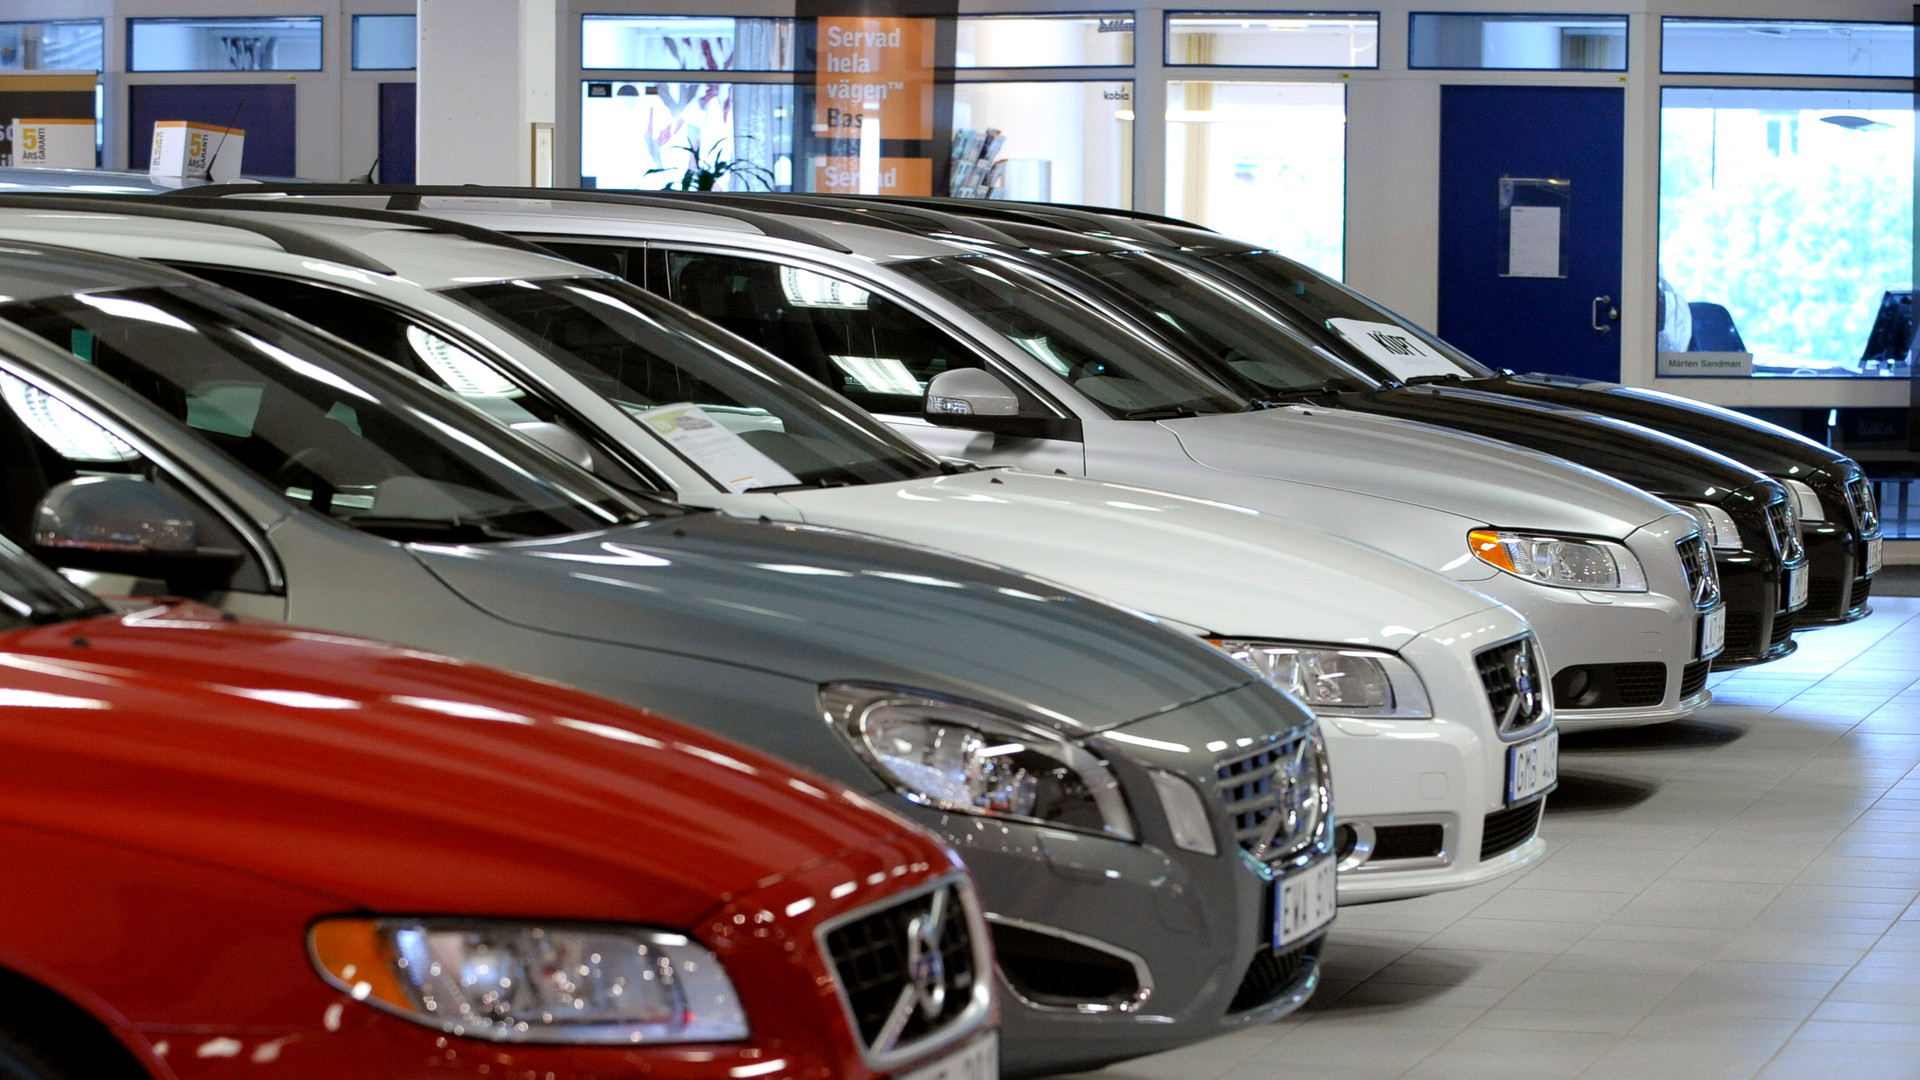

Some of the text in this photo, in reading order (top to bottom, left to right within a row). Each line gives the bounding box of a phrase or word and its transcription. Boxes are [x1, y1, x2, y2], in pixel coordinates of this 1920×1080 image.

[828, 26, 901, 48] Servad
[827, 52, 871, 73] hela
[22, 127, 38, 150] 5
[38, 127, 46, 160] GARANTI
[190, 132, 202, 157] 5
[825, 166, 897, 188] Serd
[1701, 359, 1741, 368] Sandman
